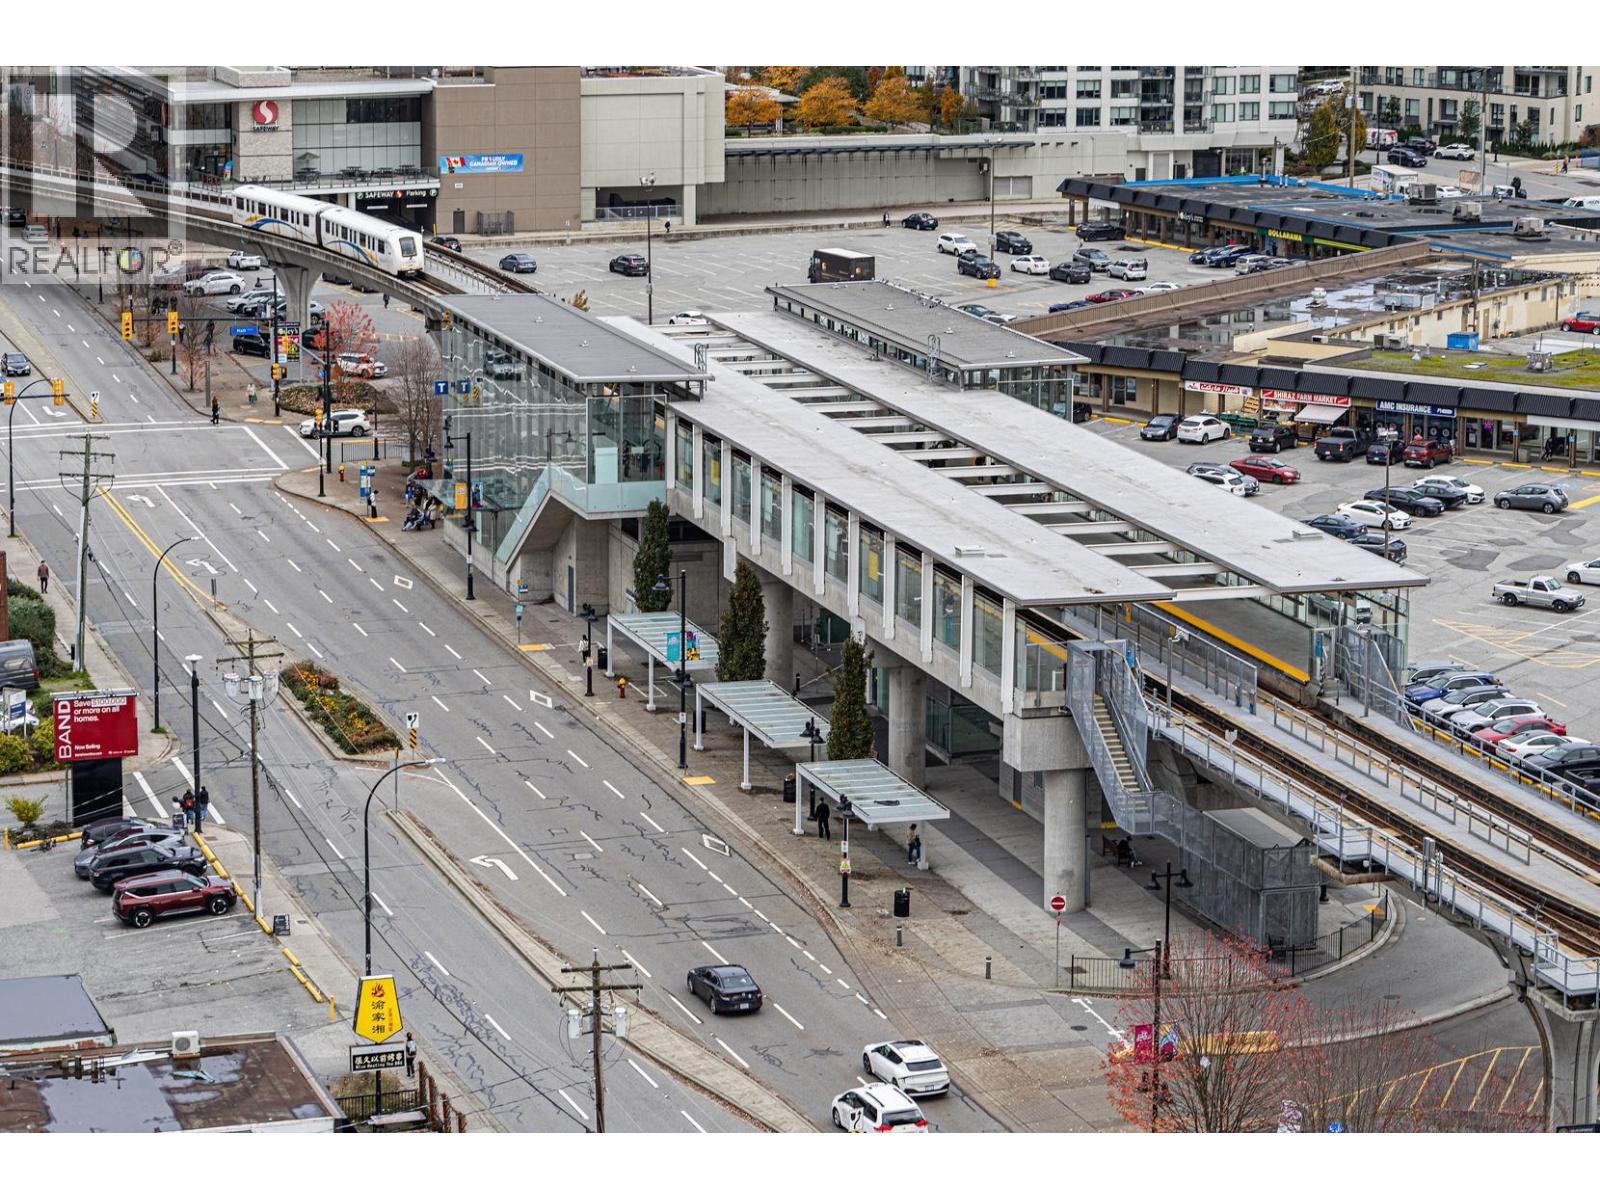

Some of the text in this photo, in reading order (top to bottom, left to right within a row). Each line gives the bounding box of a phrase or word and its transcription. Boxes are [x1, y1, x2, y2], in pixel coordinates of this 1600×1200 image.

[365, 191, 394, 199] SAFEWAY
[1267, 228, 1302, 242] DOLLARAMA
[1273, 391, 1337, 404] SHIRAZ FARM MARKET
[1380, 401, 1395, 410] AMC
[1396, 402, 1432, 413] INSURANCE
[74, 715, 99, 723] homes.
[58, 701, 72, 758] BAND
